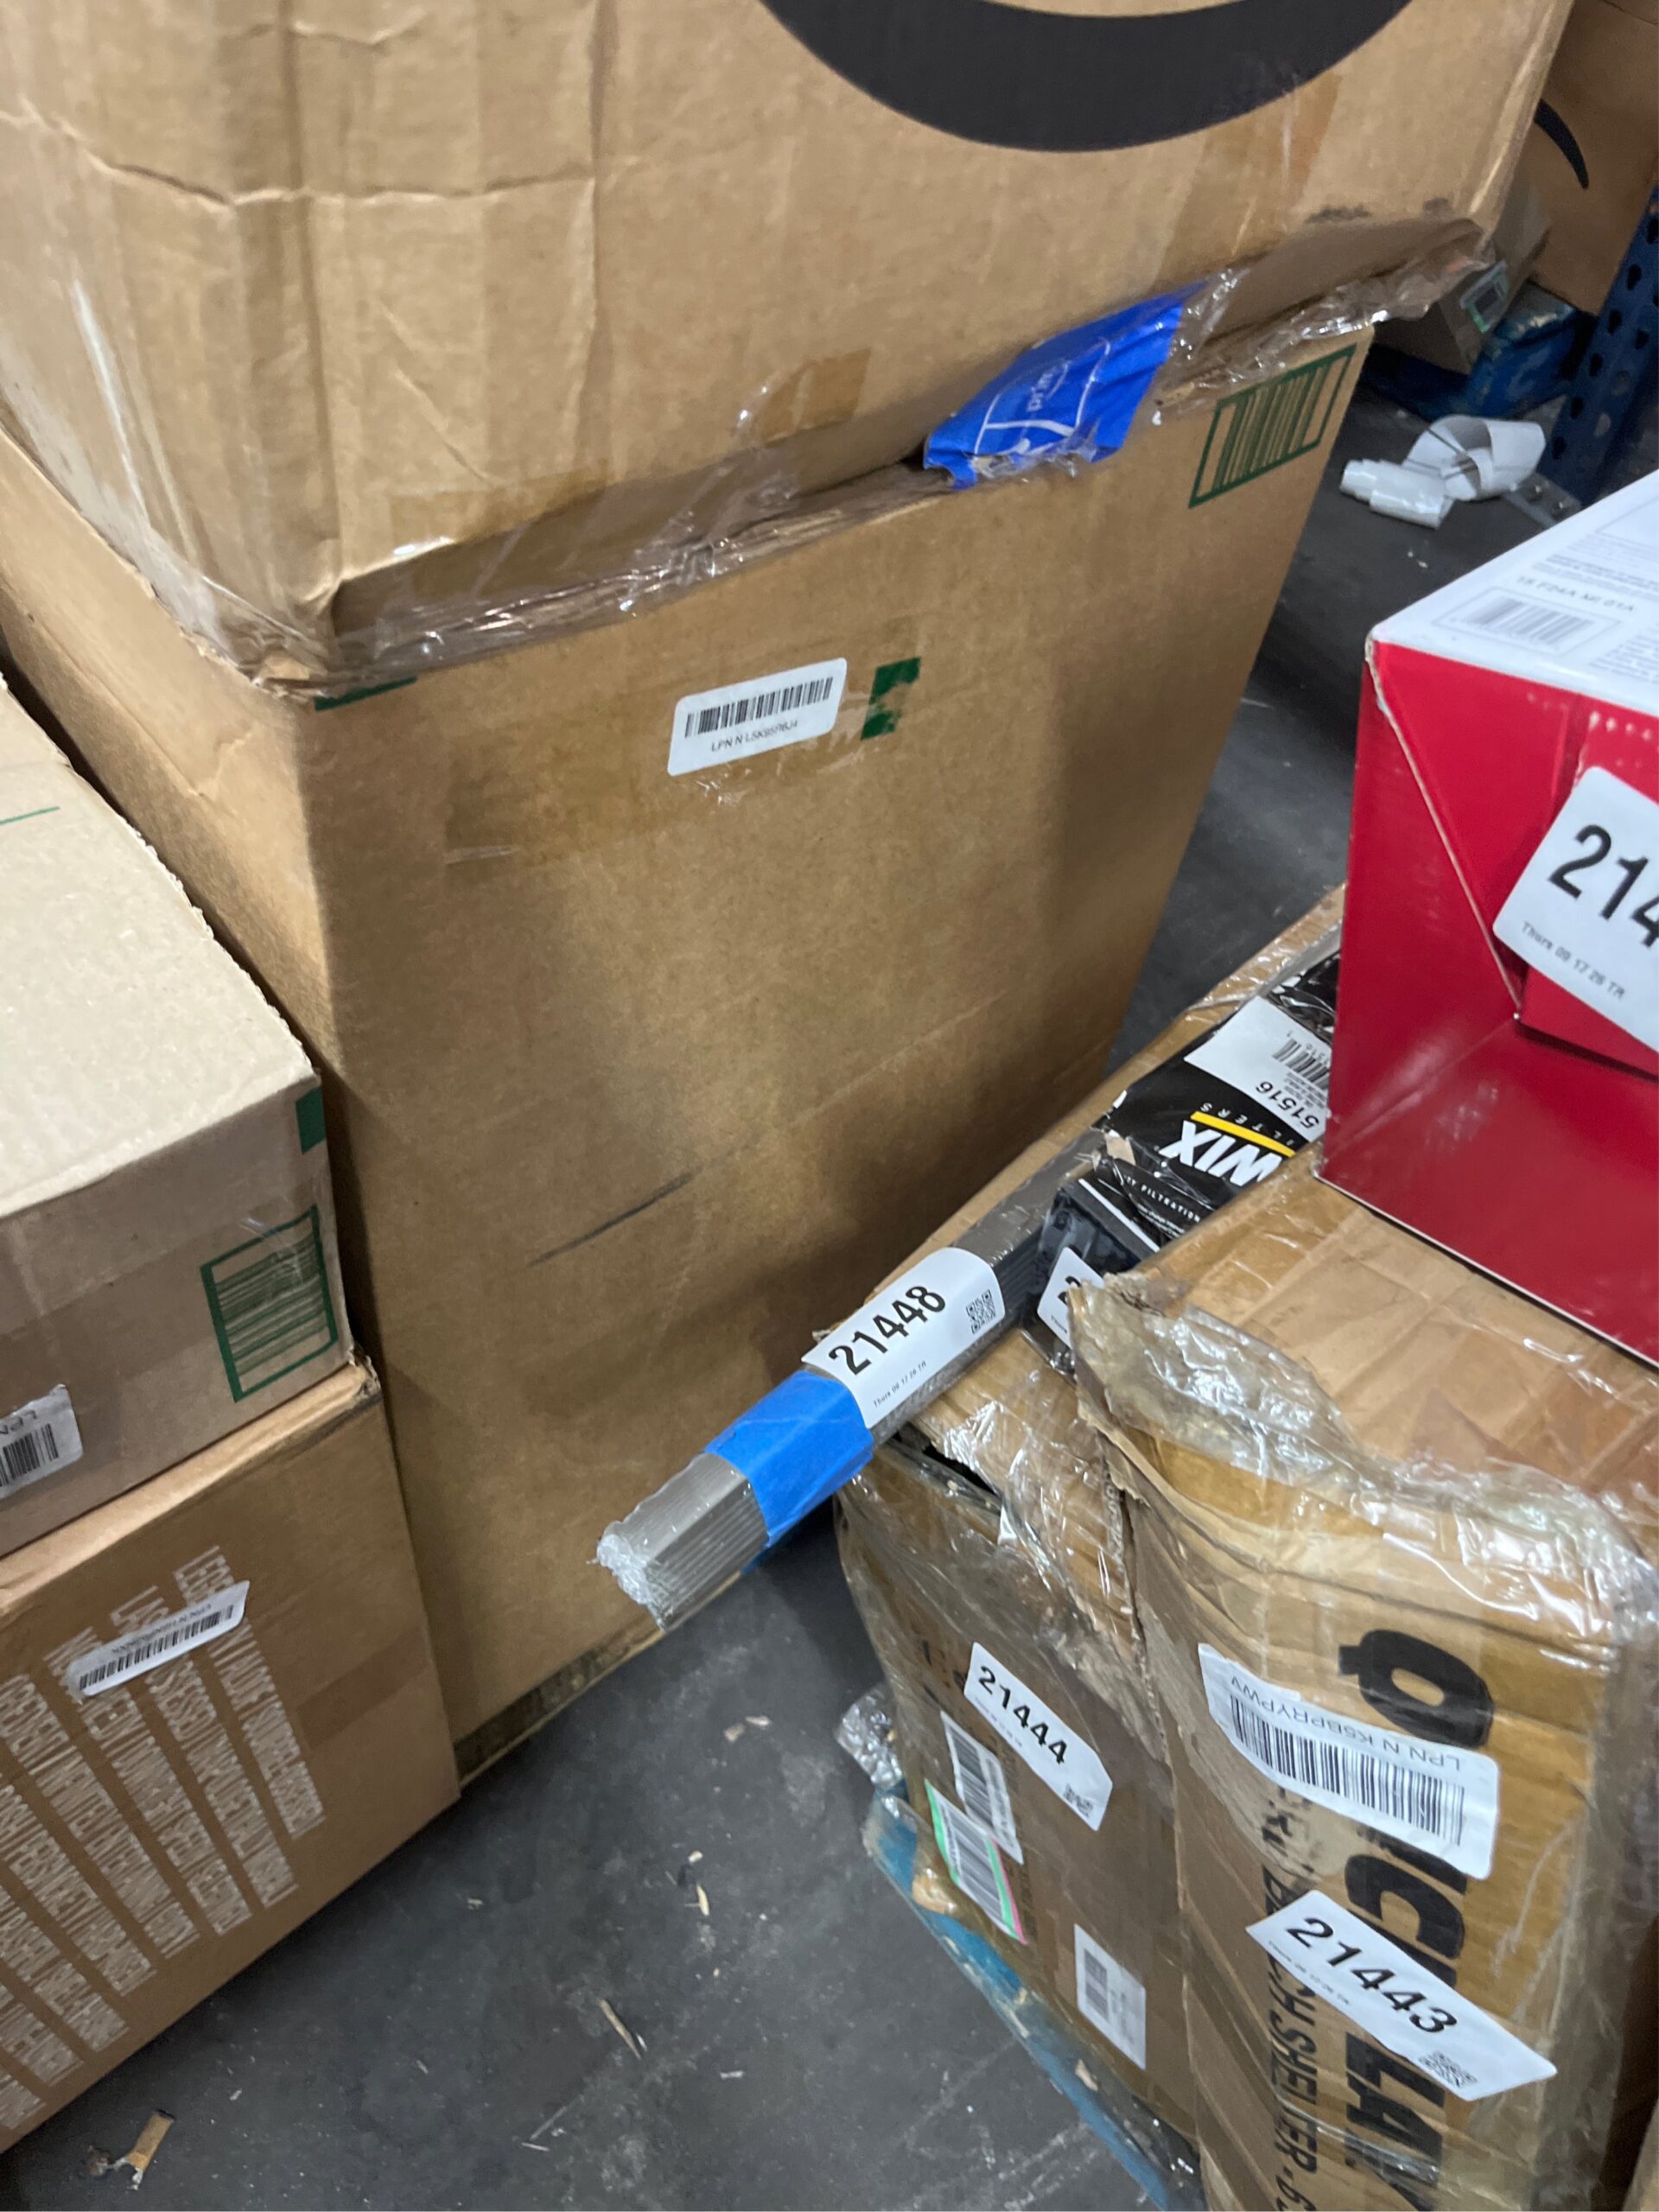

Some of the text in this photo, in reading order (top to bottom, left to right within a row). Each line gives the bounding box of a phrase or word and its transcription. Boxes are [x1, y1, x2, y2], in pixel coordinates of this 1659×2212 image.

[711, 736, 734, 753] LPN
[735, 734, 744, 747] N
[1199, 1102, 1297, 1146] ILTERS
[1255, 1081, 1320, 1131] 51516
[1157, 1120, 1283, 1187] WIX
[1141, 1183, 1203, 1224] FILTRATION
[828, 1285, 946, 1376] 21448
[977, 1665, 1068, 1766] 21444
[1382, 1739, 1403, 1756] N
[1409, 1746, 1462, 1771] LPN
[1284, 1916, 1459, 2035] 21443
[1269, 2010, 1318, 2175] SHELTER
